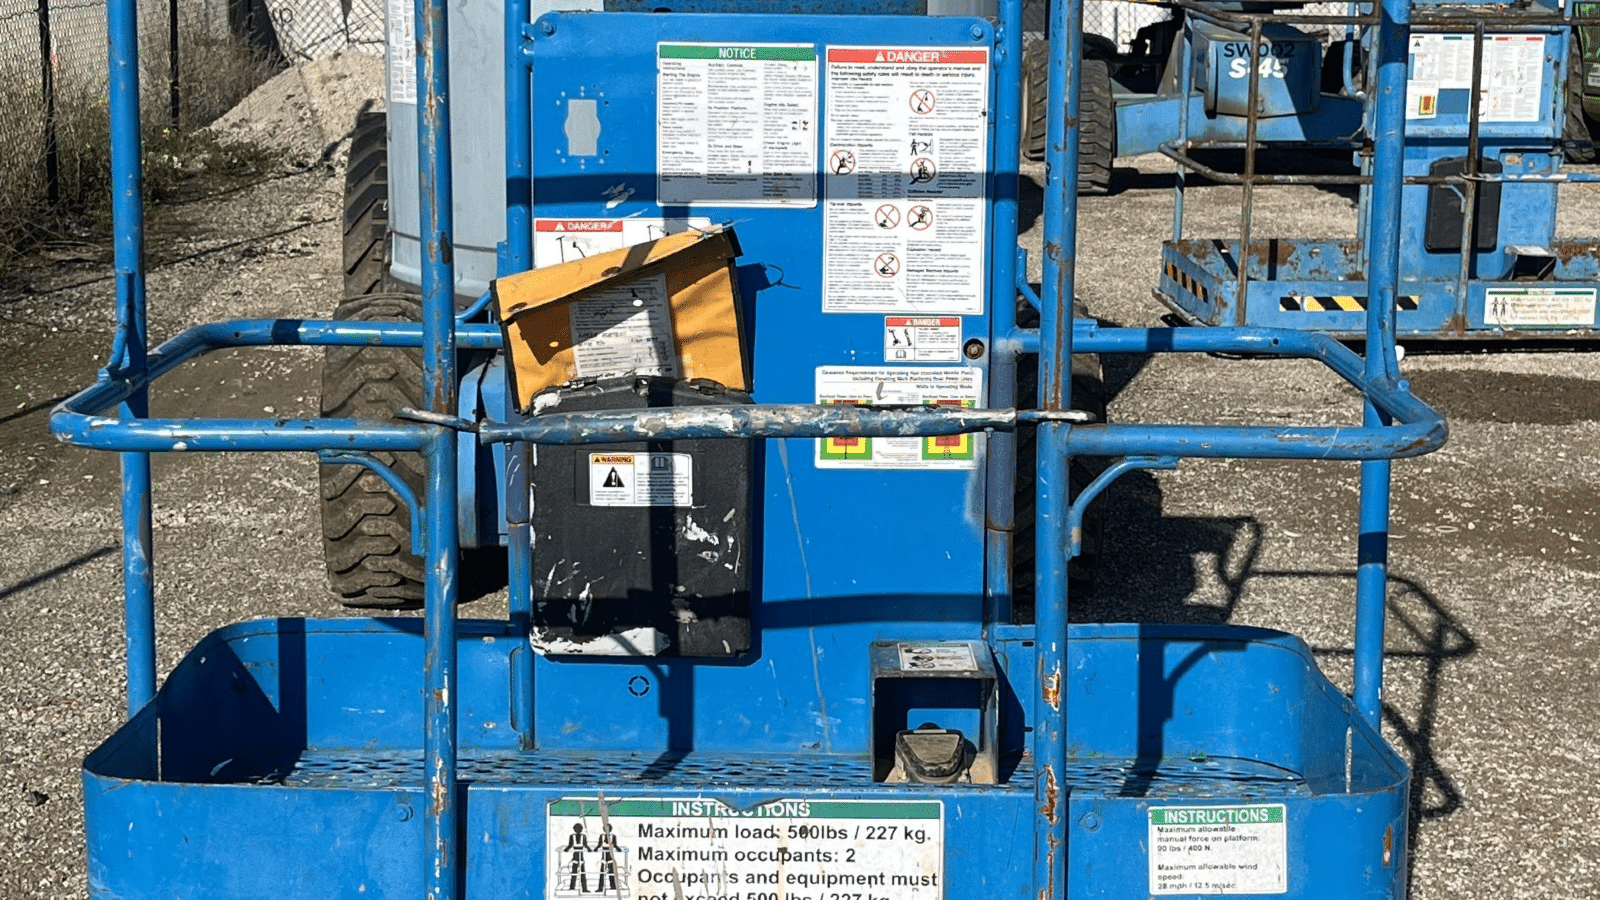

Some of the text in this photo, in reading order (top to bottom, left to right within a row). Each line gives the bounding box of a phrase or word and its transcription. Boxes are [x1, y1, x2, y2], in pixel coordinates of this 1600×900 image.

[718, 47, 757, 59] NOTICE
[886, 50, 940, 63] DANGER
[1223, 42, 1295, 58] SW002
[567, 221, 607, 231] DANGER
[913, 318, 941, 326] DANGER
[1164, 808, 1269, 823] INSTRUCTIONS
[638, 823, 932, 844] Maximum load: 500lbs / 227 kg.
[1169, 844, 1181, 852] lbs
[638, 846, 856, 866] Maximum occupants: 2
[638, 868, 938, 888] Occupans and equipment must
[1169, 882, 1187, 891] mph
